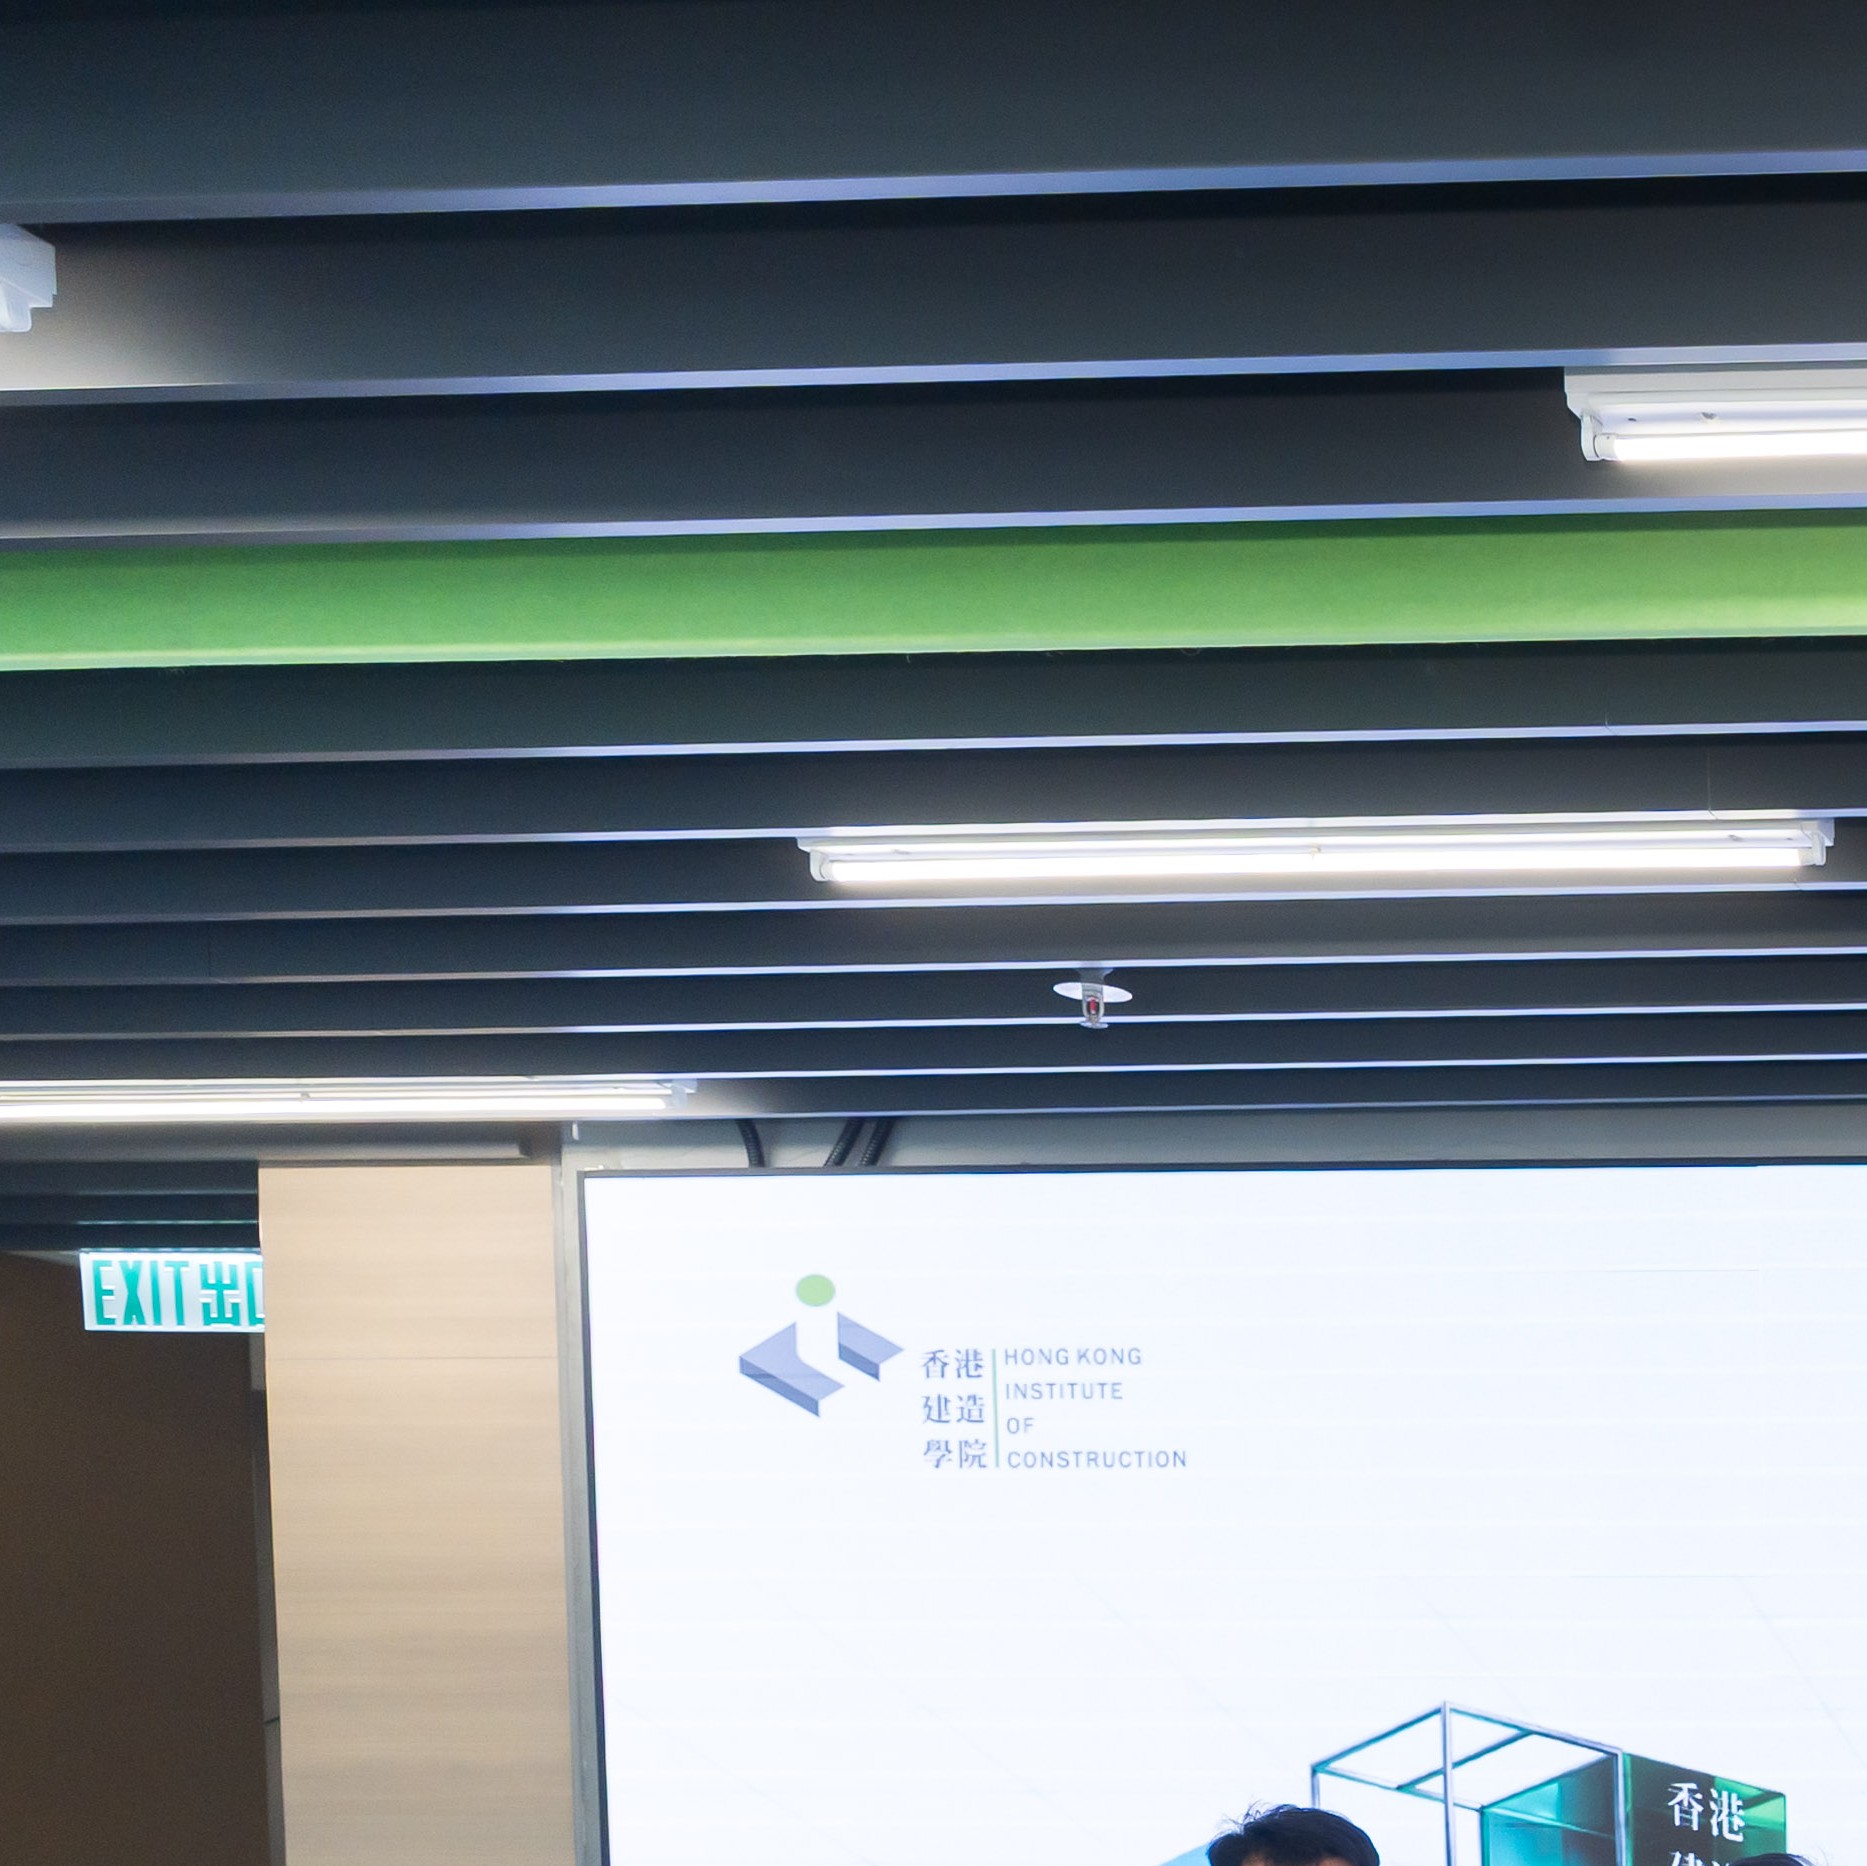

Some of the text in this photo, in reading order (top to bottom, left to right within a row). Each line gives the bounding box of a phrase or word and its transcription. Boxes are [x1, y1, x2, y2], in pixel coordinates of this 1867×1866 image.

[92, 1260, 189, 1326] EXIT
[921, 1349, 984, 1379] 香港
[1004, 1348, 1142, 1365] HONG KONG
[1005, 1382, 1123, 1400] INSTITUTE
[922, 1394, 985, 1424] 建造
[1006, 1417, 1035, 1434] OF
[923, 1438, 987, 1469] 學院
[1007, 1450, 1187, 1468] CONSTRUCTION
[1667, 1782, 1746, 1842] 香港
